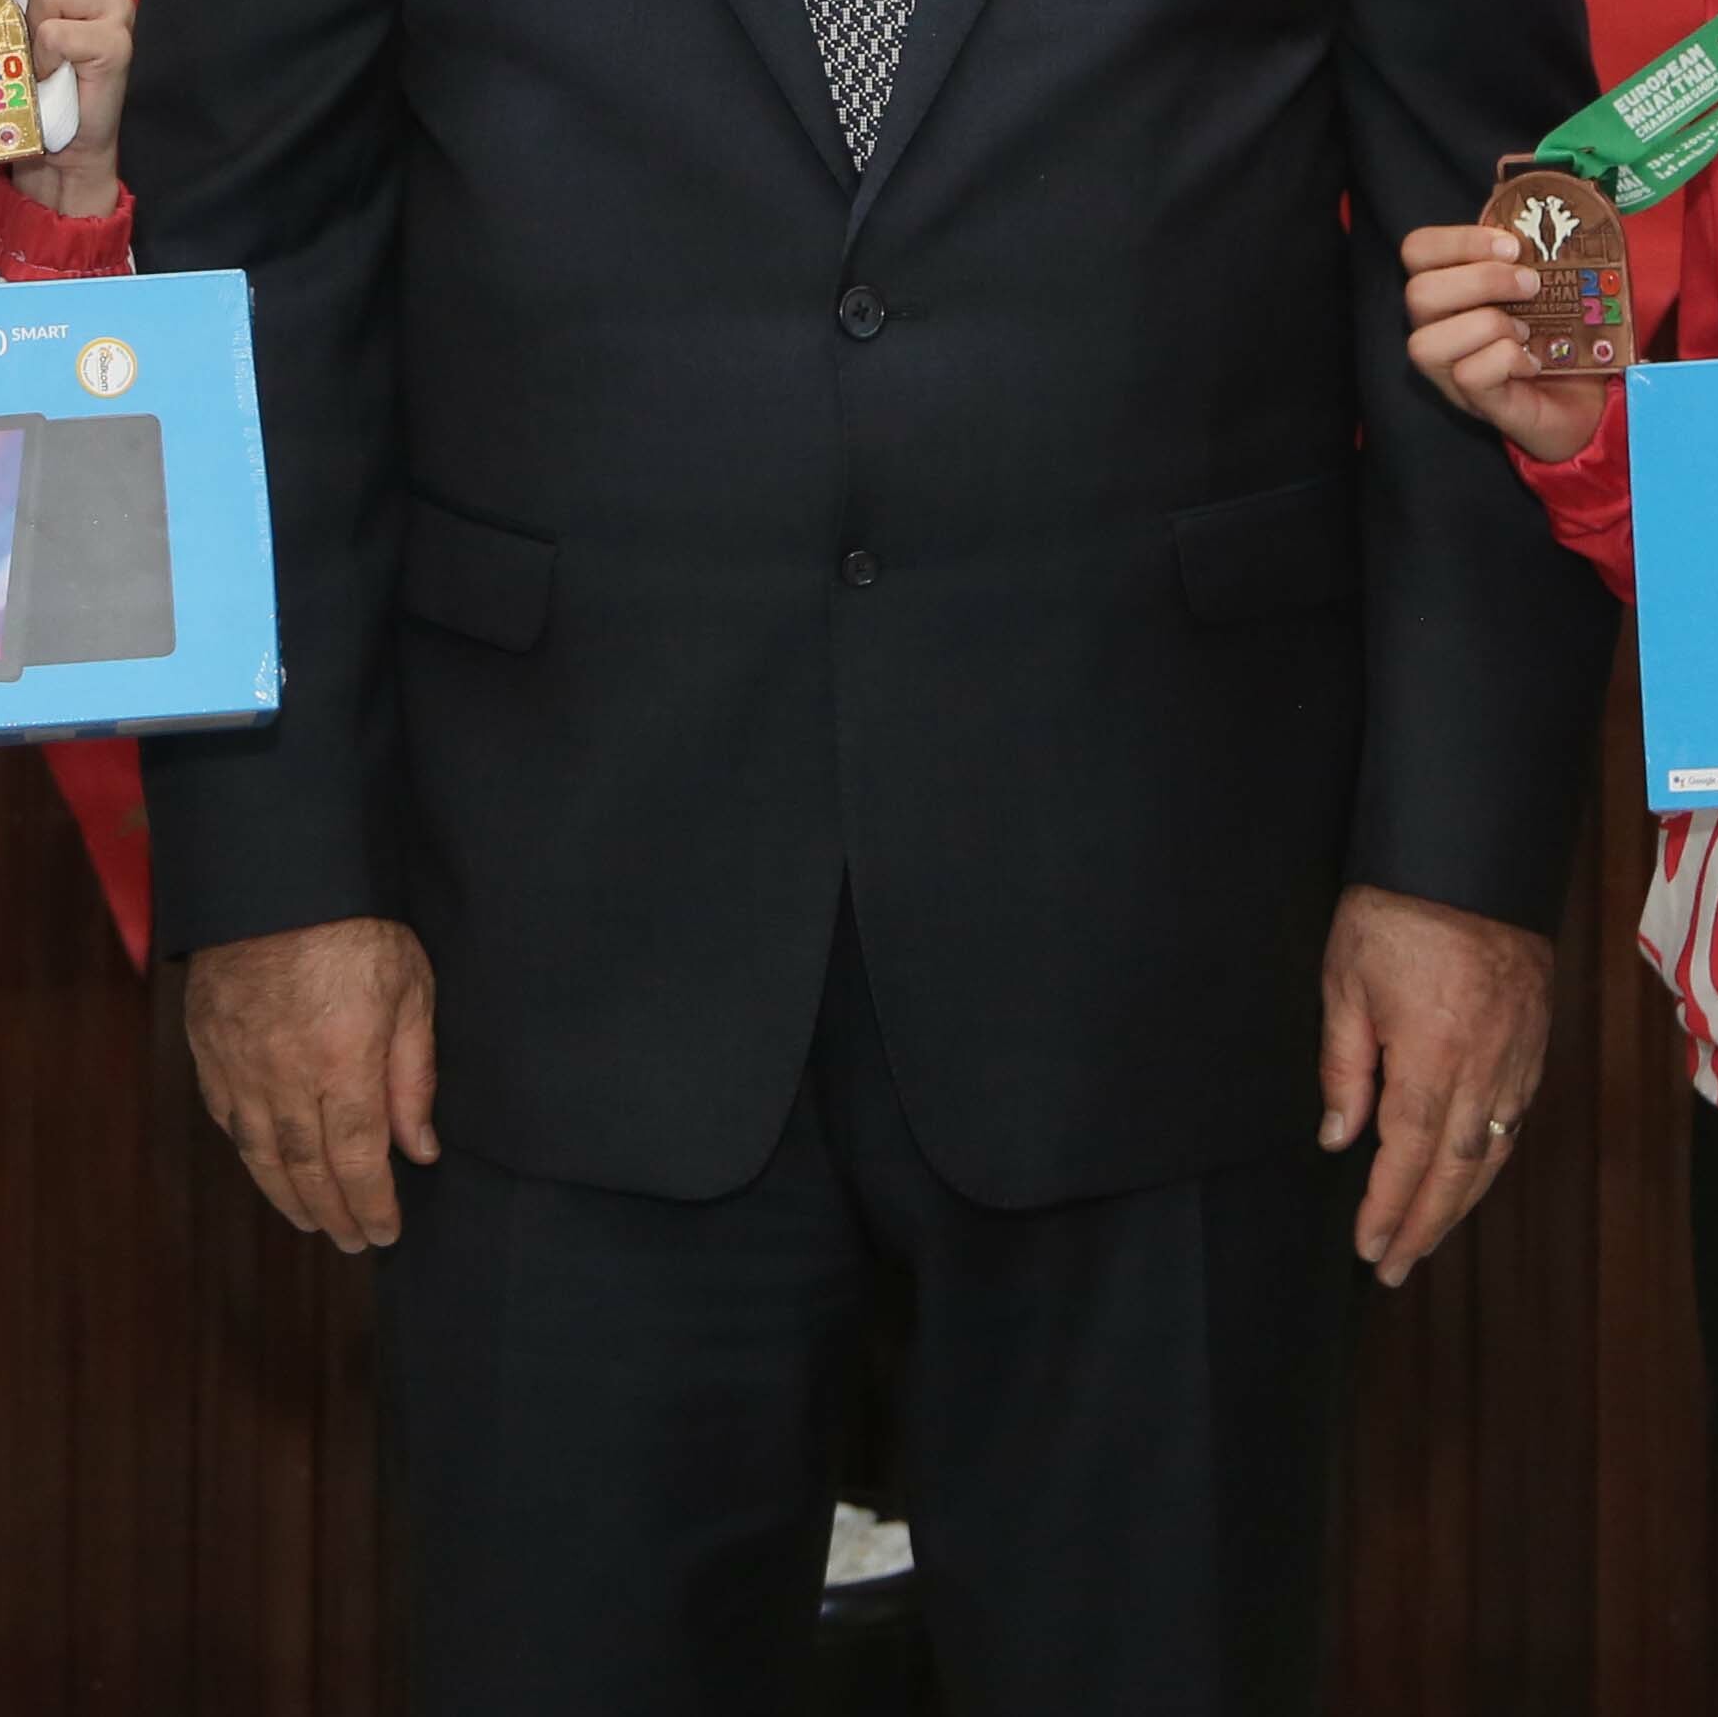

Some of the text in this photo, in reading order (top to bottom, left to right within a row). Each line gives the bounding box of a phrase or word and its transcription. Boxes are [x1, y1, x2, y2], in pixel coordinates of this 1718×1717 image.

[1612, 43, 1706, 116] EUROPEAN
[1623, 57, 1717, 129] MUAYTHAI
[11, 324, 69, 342] SMART
